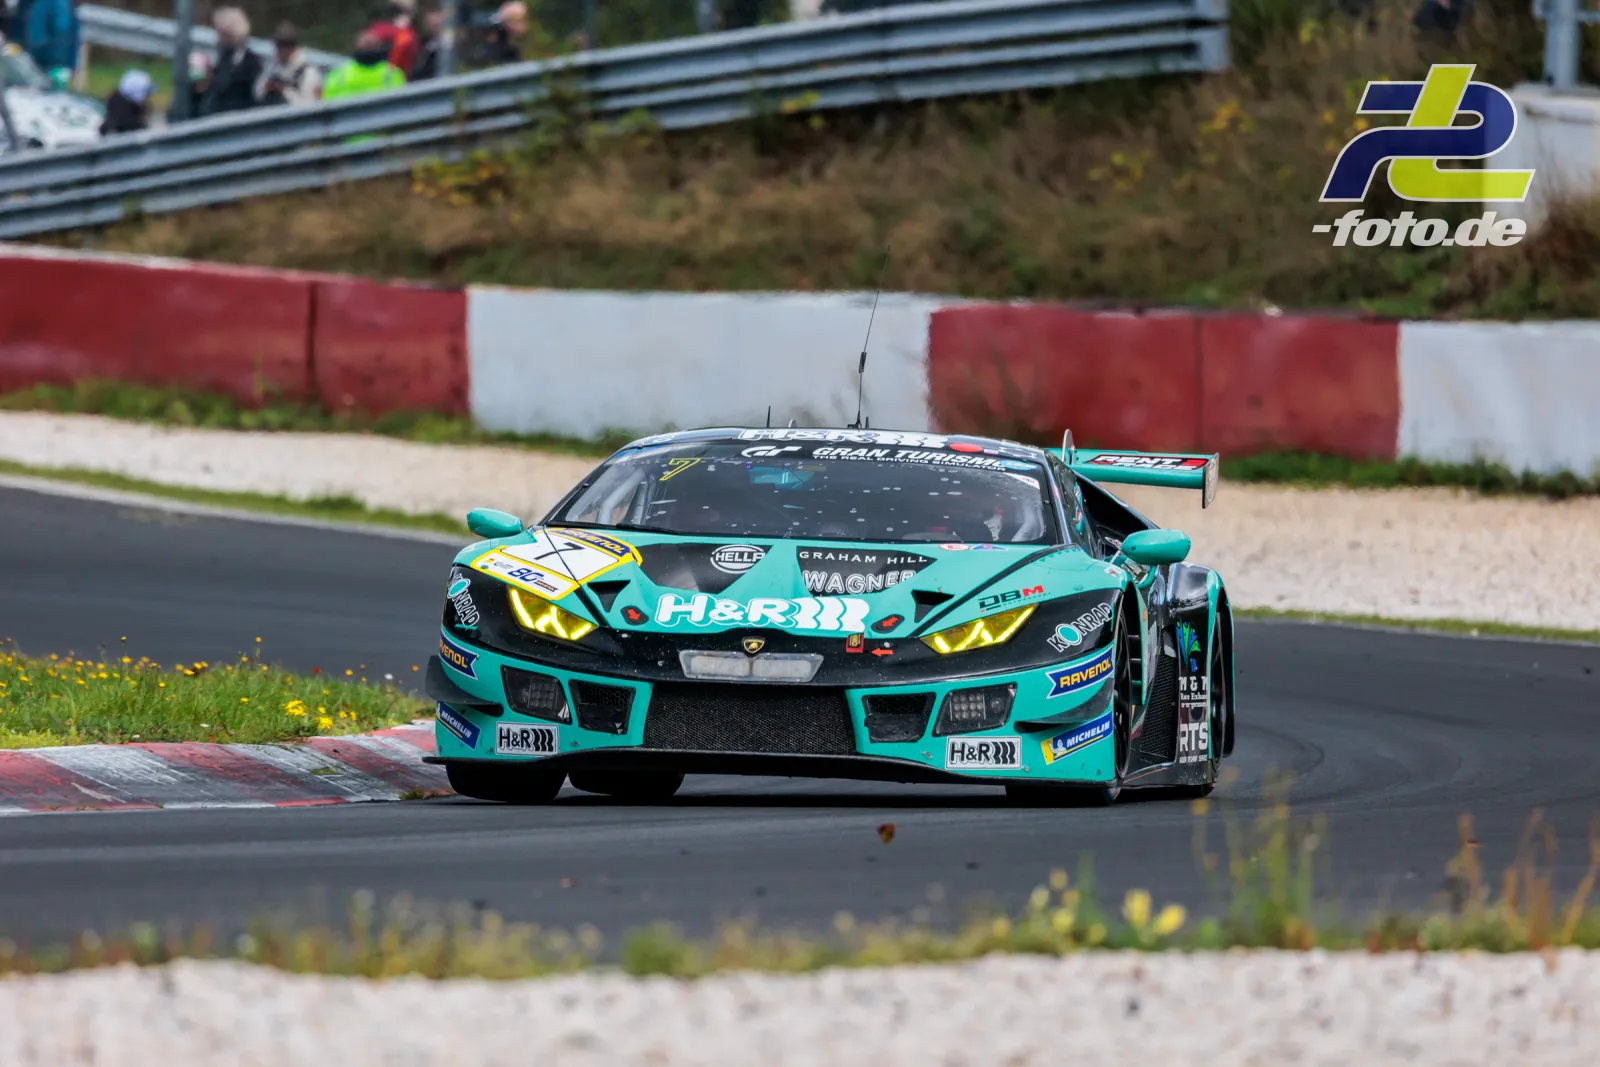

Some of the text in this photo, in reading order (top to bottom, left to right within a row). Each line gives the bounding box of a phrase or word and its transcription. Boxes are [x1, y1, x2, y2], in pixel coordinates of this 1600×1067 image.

[812, 447, 890, 458] GRAN
[932, 460, 1006, 472] SIMULATOR
[534, 542, 585, 561] 7
[799, 551, 928, 565] GRAHAM HILL
[978, 585, 1044, 609] DBM
[655, 594, 800, 627] H&R
[1046, 603, 1113, 653] KONRAD
[1059, 658, 1111, 689] RAVENOL
[441, 710, 472, 739] MICHELIN
[1066, 720, 1110, 748] MICHELIN
[1179, 721, 1208, 751] RTS
[499, 726, 533, 750] H&R
[950, 741, 993, 765] H&R
